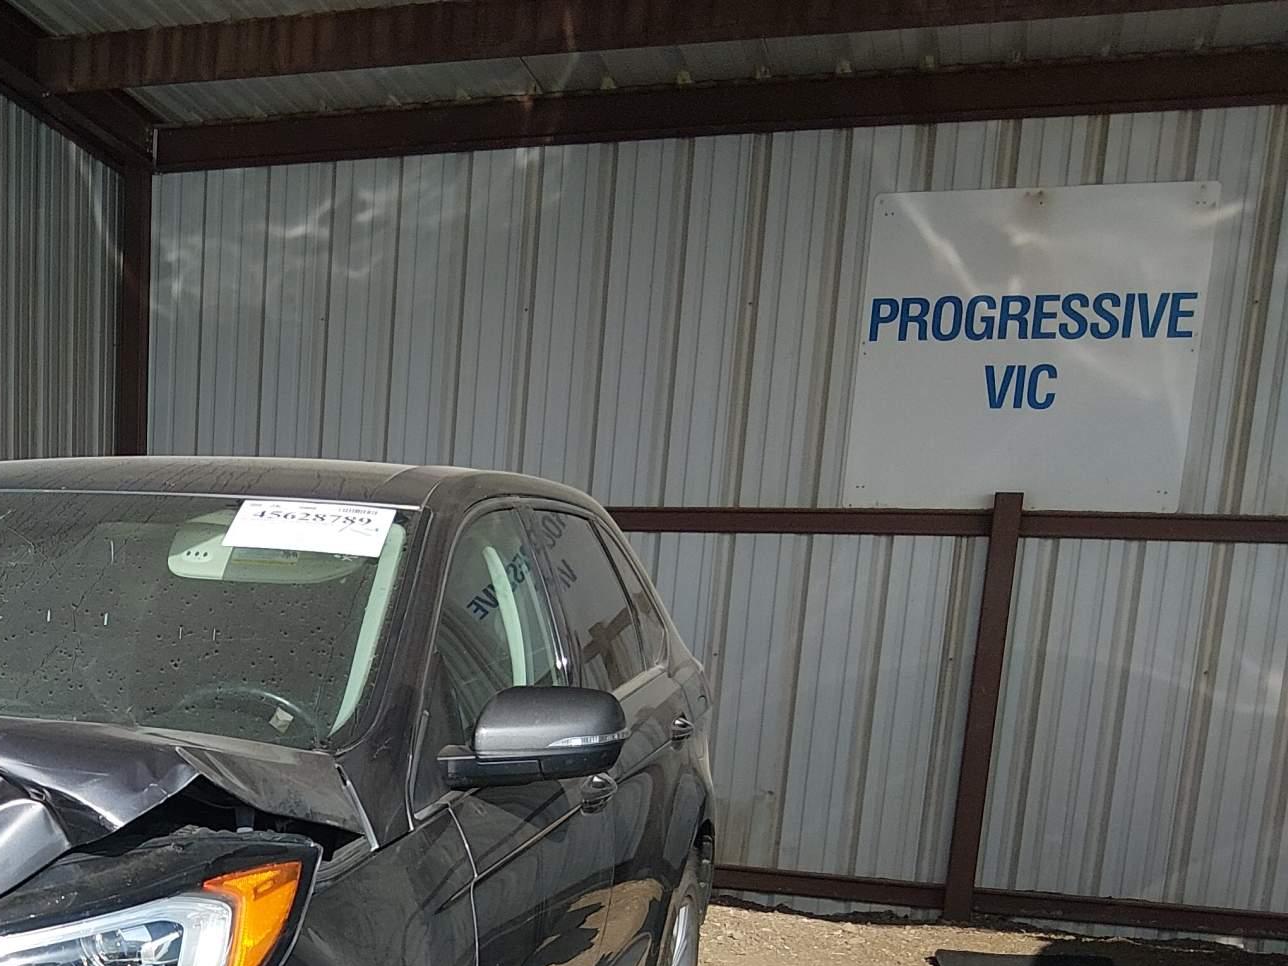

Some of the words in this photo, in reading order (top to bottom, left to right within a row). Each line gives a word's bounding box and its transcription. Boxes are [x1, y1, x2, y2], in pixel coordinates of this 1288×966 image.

[868, 291, 1199, 343] PROGRESSIVE
[983, 363, 1058, 411] VIC
[252, 509, 373, 527] 45628789
